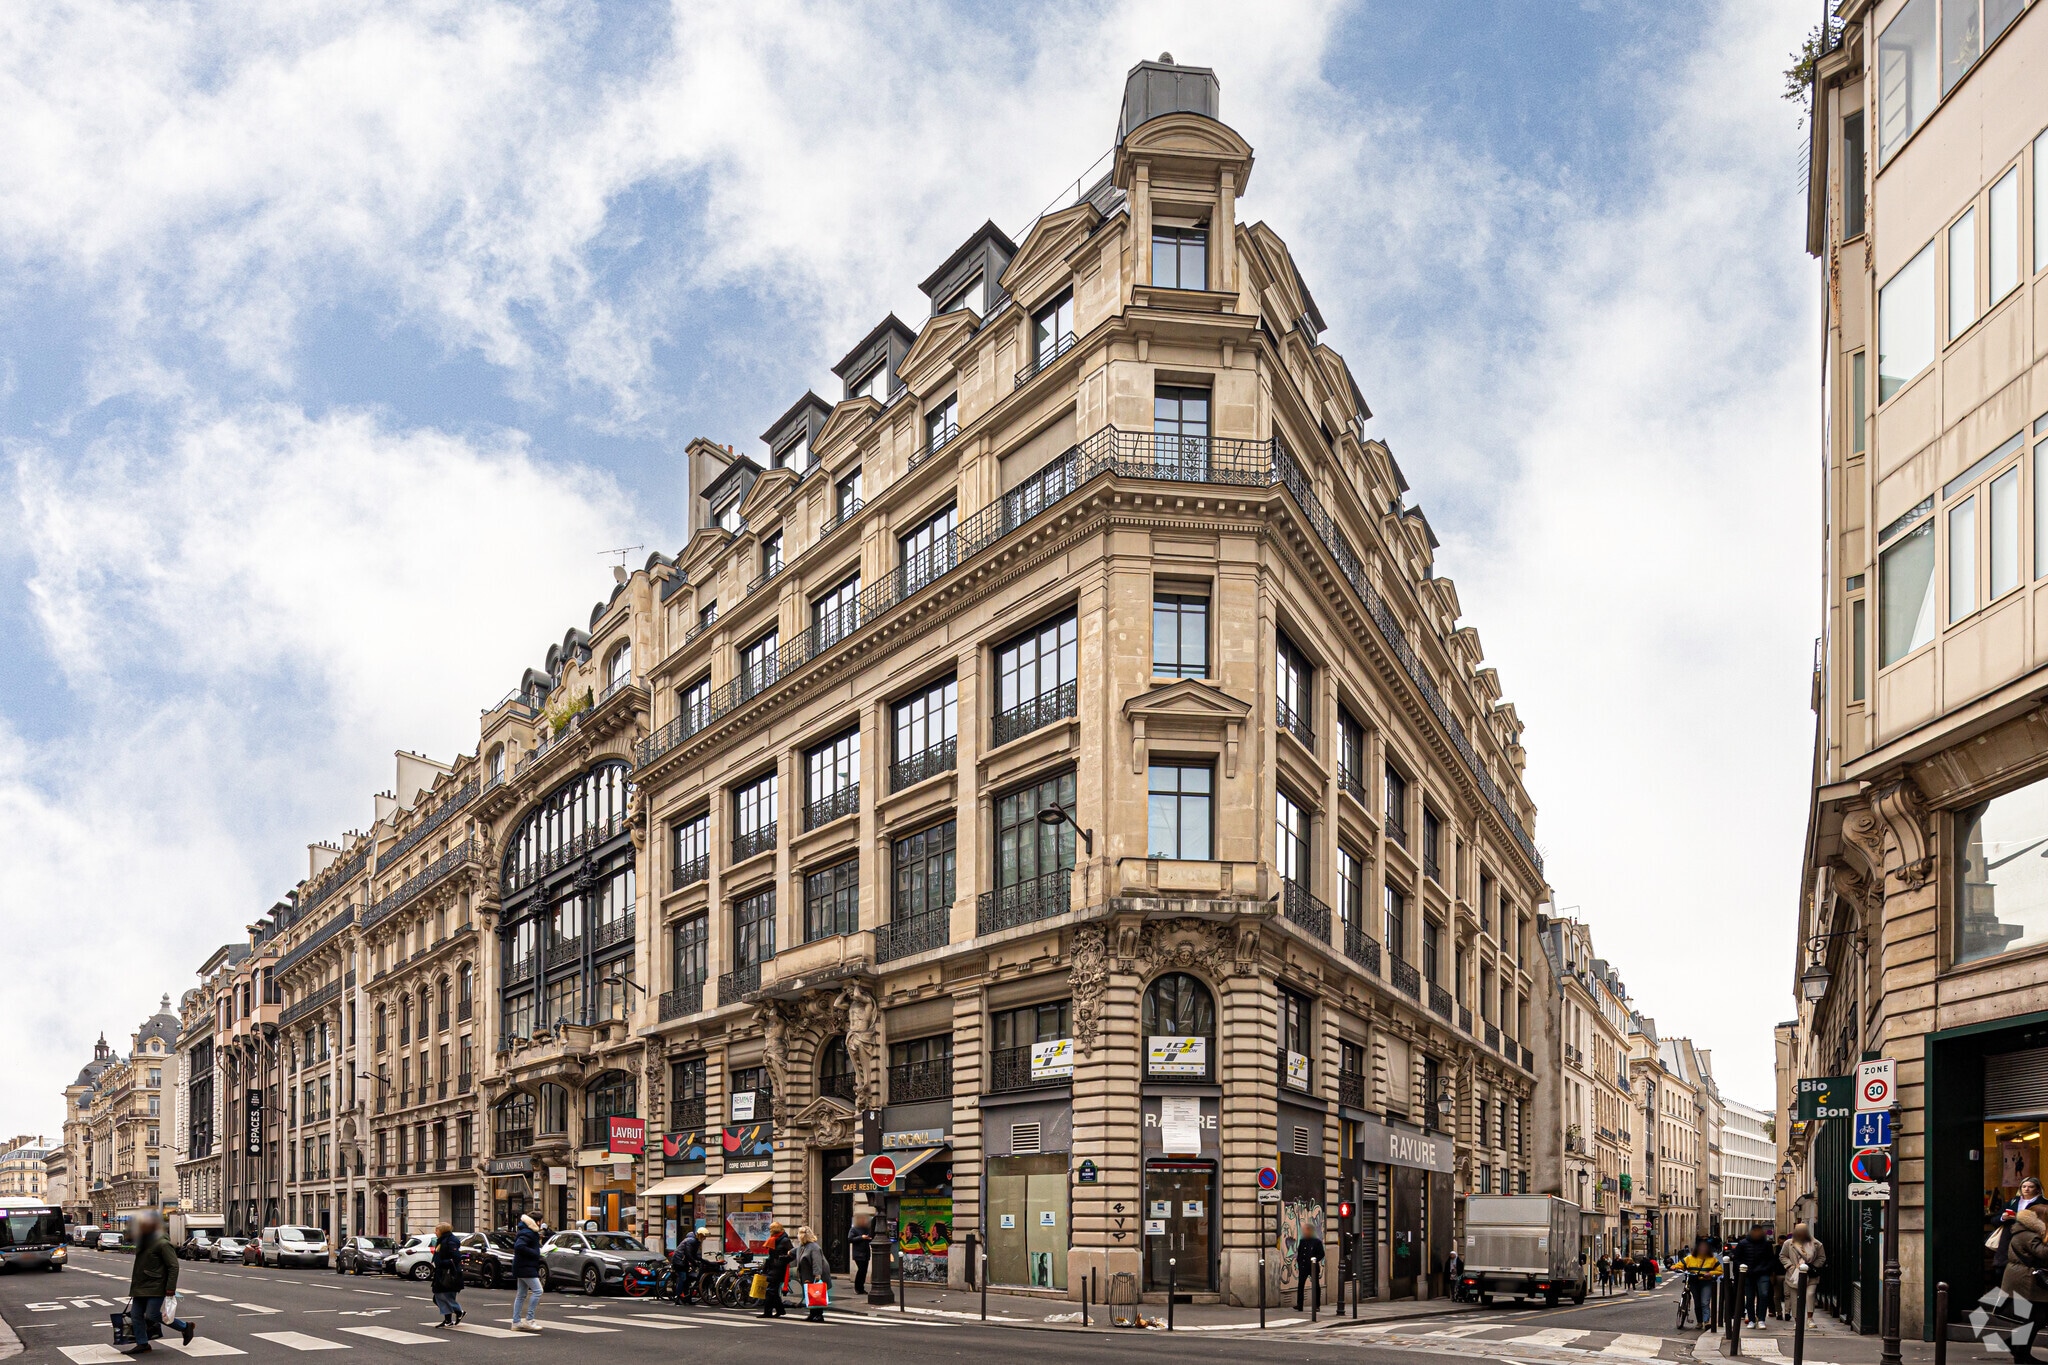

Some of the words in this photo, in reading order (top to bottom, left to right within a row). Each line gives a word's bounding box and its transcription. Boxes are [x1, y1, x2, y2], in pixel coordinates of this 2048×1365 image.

[1044, 1043, 1072, 1054] IDF
[1293, 1058, 1306, 1067] IDF
[1864, 1065, 1889, 1075] ZONE
[1800, 1080, 1828, 1092] Bio
[1868, 1085, 1884, 1096] 30
[1816, 1106, 1849, 1118] Bon
[1144, 1113, 1217, 1129] RRE
[611, 1126, 643, 1139] LAVRUT
[882, 1134, 896, 1147] LE
[1390, 1134, 1436, 1165] RAYURE
[496, 1162, 504, 1171] LOU
[506, 1161, 524, 1170] ANDREA
